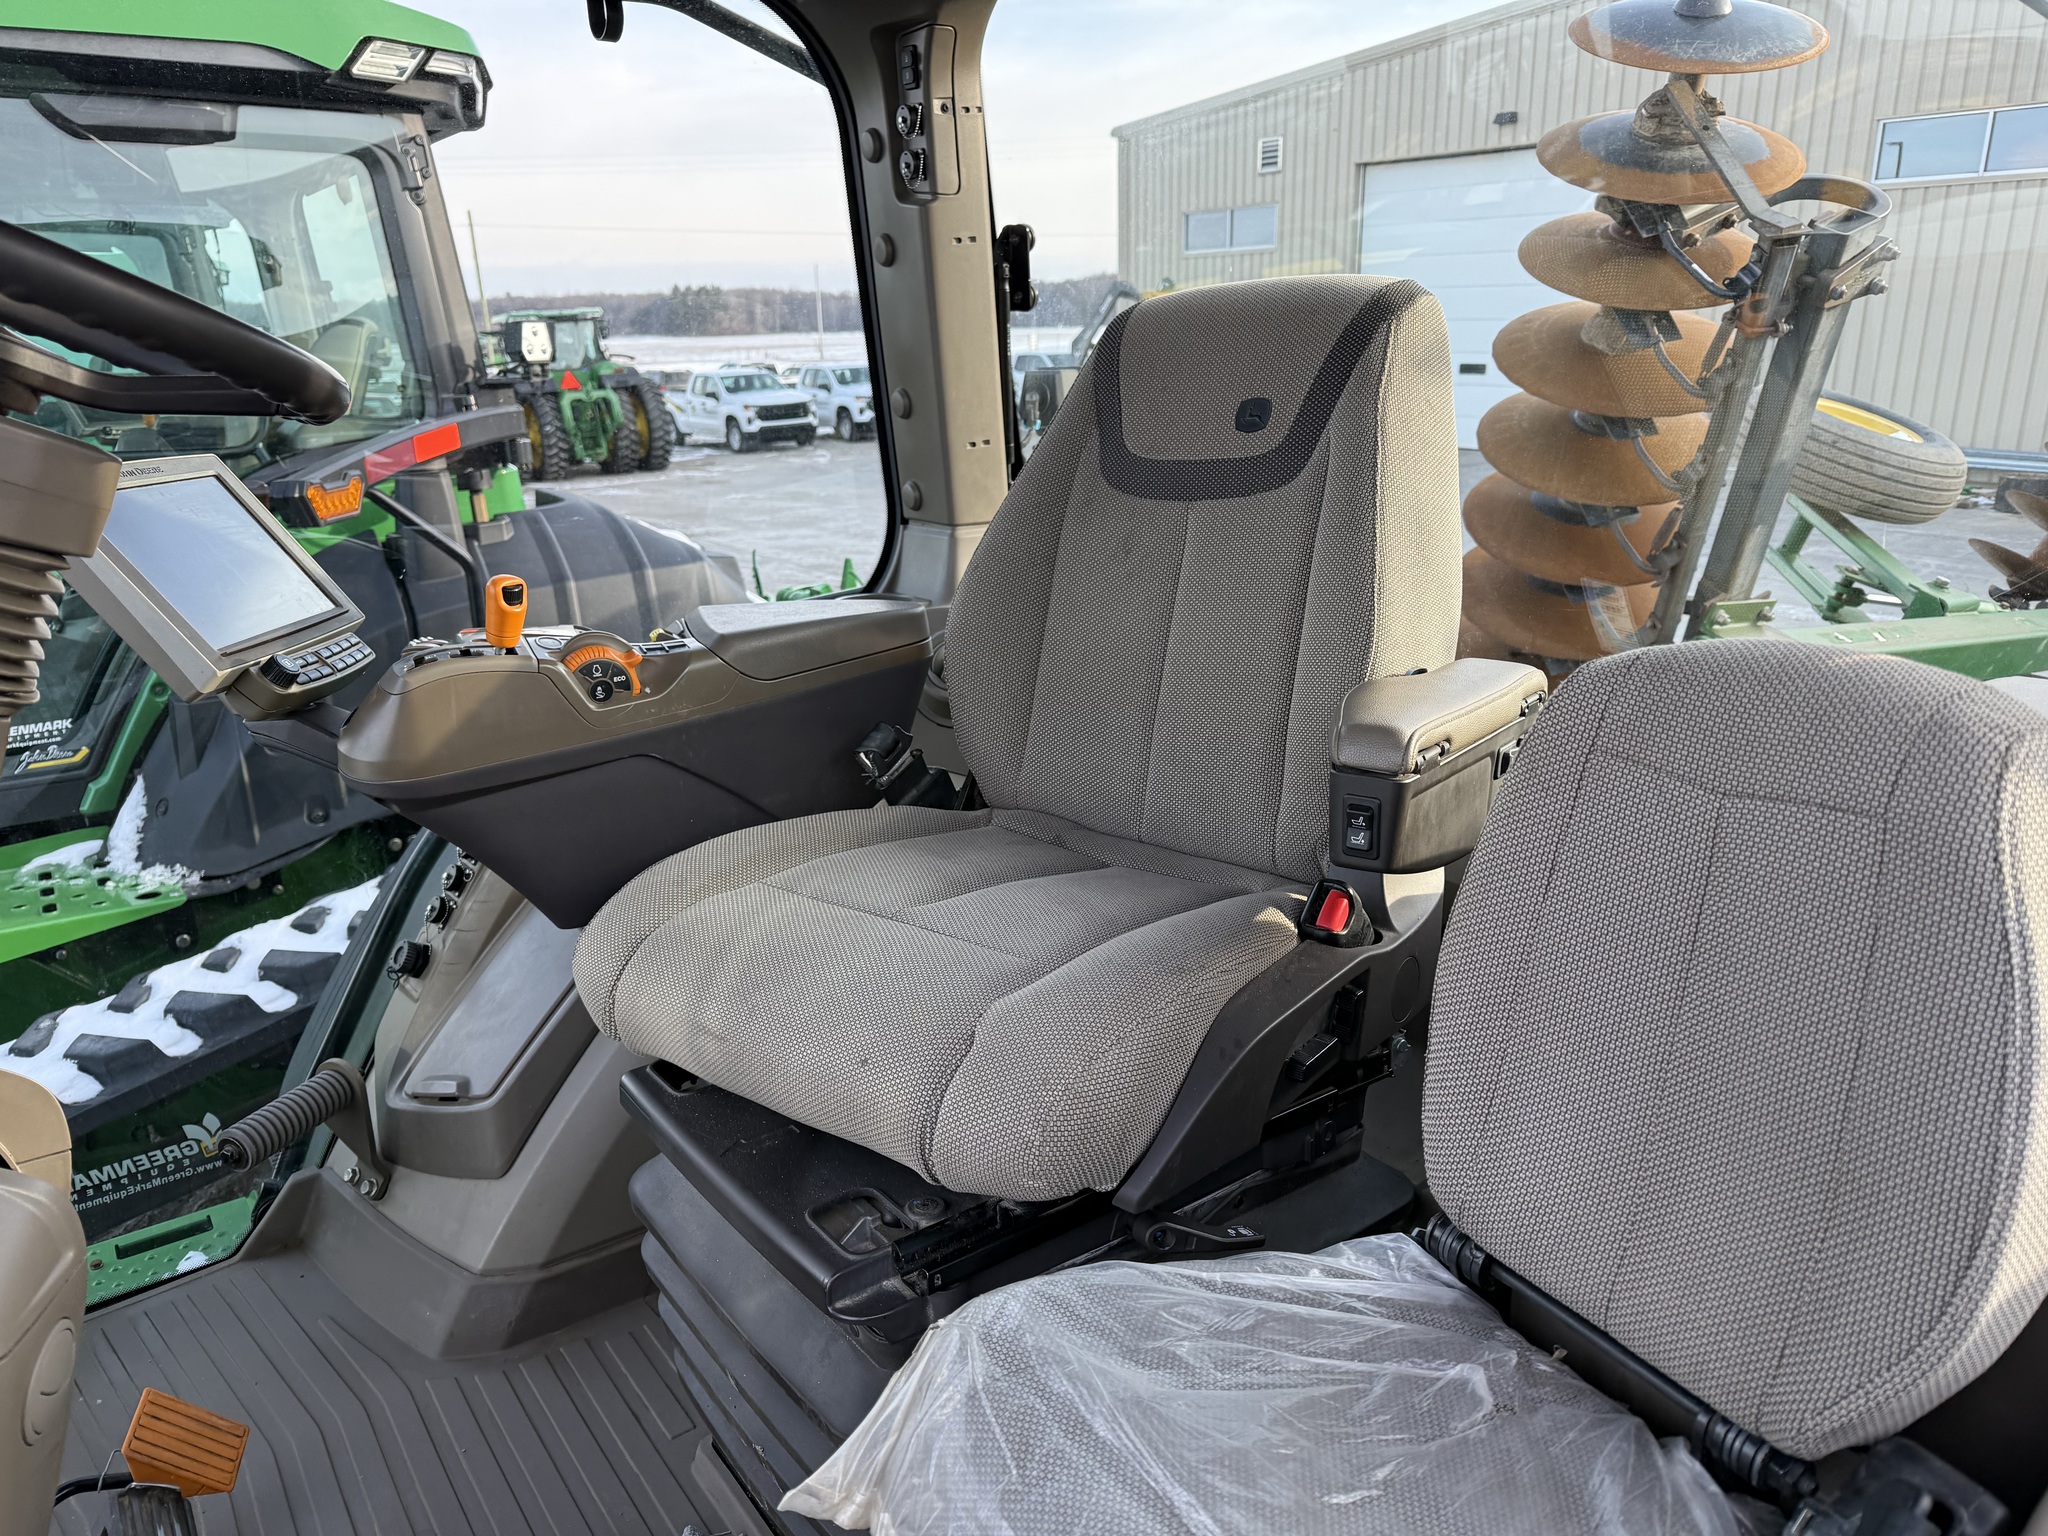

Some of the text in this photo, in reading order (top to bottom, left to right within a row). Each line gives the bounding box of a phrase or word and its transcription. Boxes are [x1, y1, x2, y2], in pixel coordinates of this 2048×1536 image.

[119, 469, 137, 478] OHN
[9, 718, 73, 736] ENMARK
[8, 729, 66, 742] UIPMENT
[6, 736, 62, 749] arkEquipment.com
[14, 745, 74, 774] John Deere
